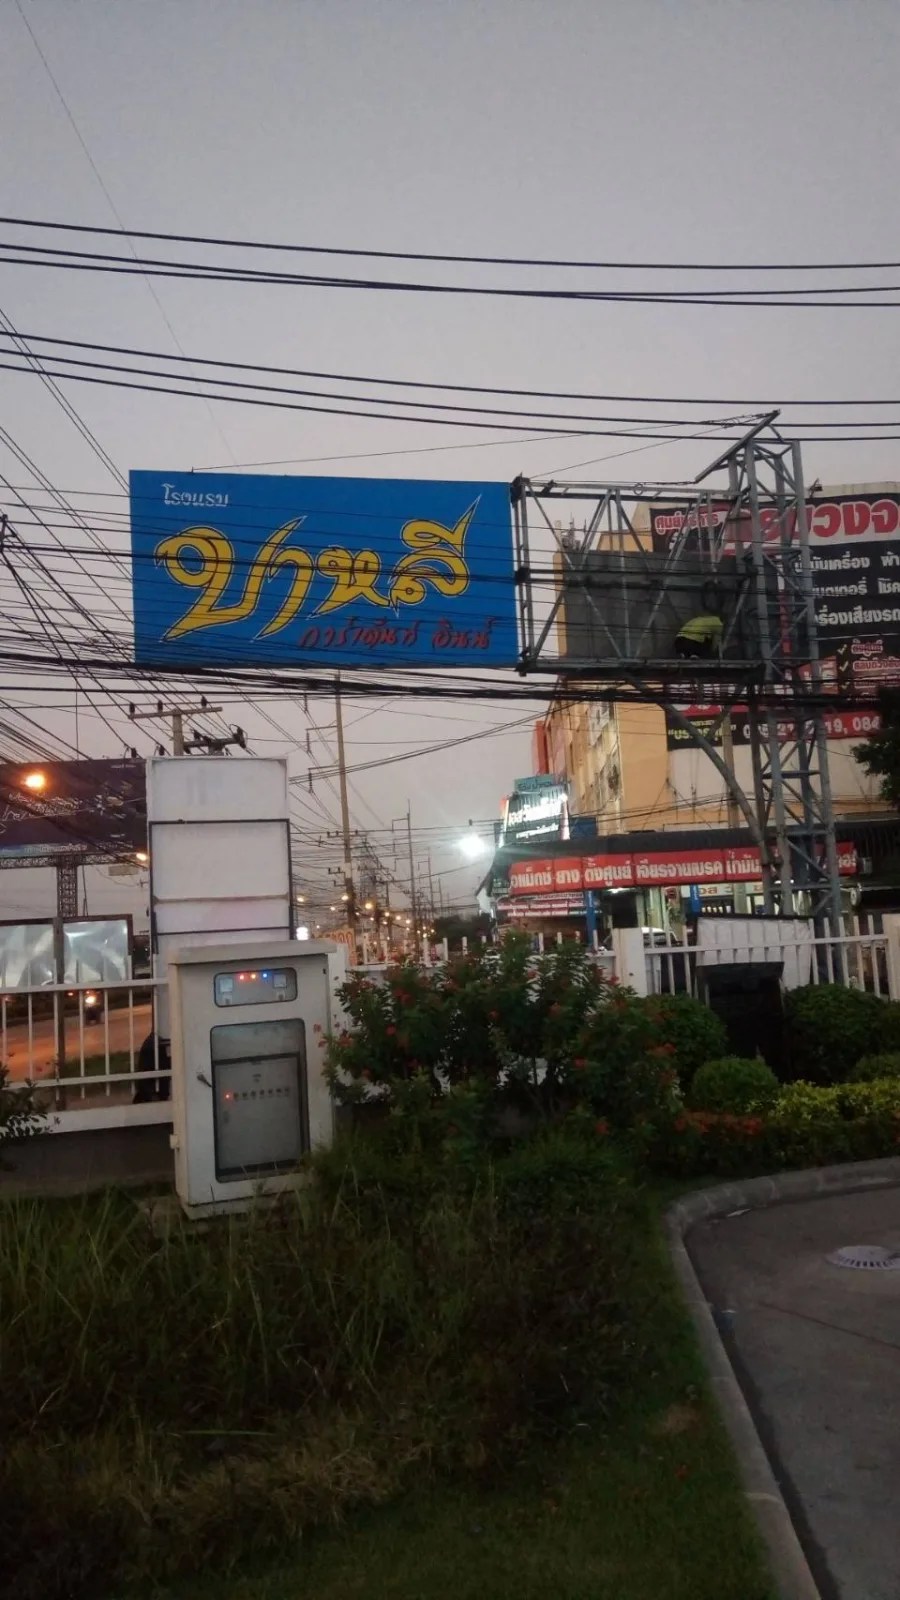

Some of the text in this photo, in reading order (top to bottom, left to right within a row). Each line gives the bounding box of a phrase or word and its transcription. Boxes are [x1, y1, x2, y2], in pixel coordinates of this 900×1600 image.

[161, 482, 230, 508] โรงแรม
[555, 868, 581, 885] ยาง
